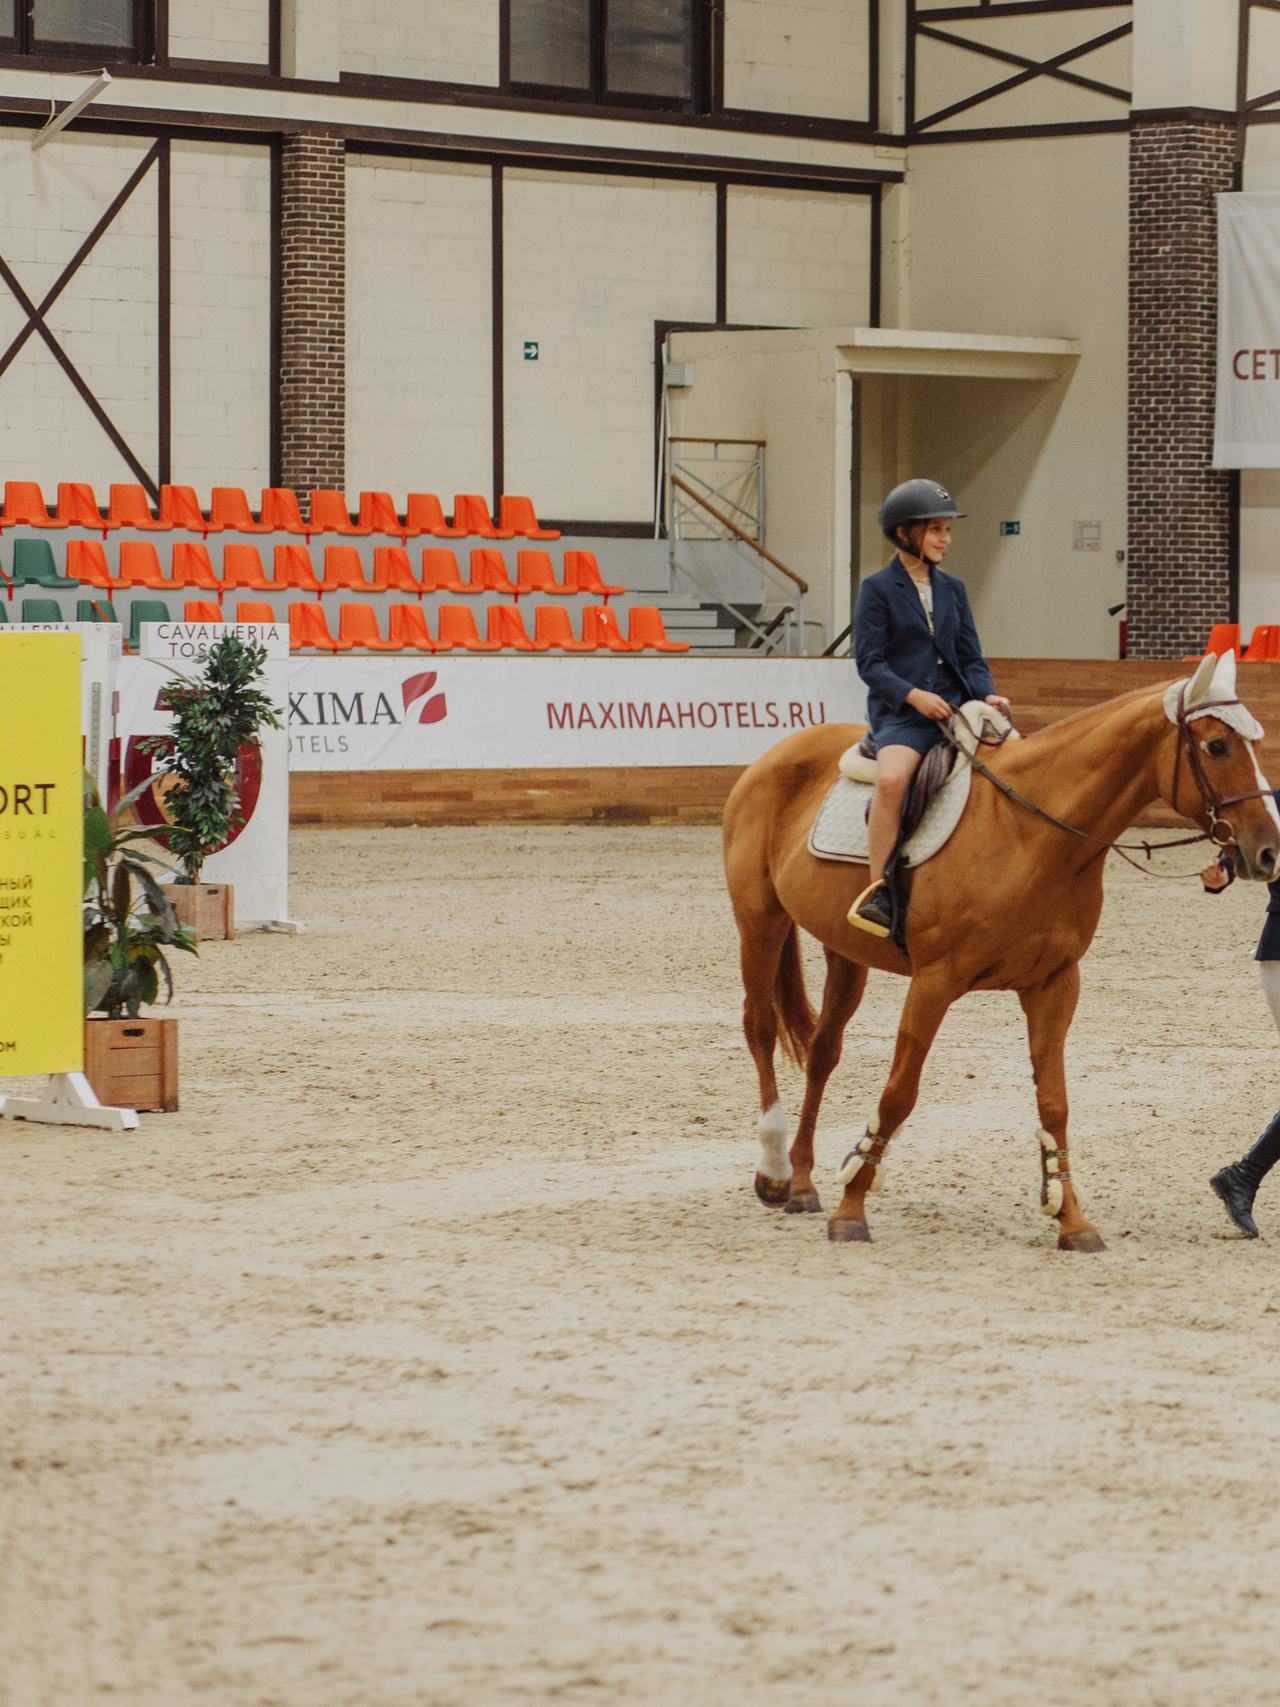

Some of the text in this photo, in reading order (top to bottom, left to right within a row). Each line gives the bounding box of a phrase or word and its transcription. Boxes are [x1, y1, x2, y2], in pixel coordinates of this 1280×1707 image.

[158, 624, 279, 640] CAVALLERIA
[546, 702, 826, 729] MAXIMAHOTELS.RU
[288, 735, 349, 753] TELS
[0, 783, 56, 815] RT
